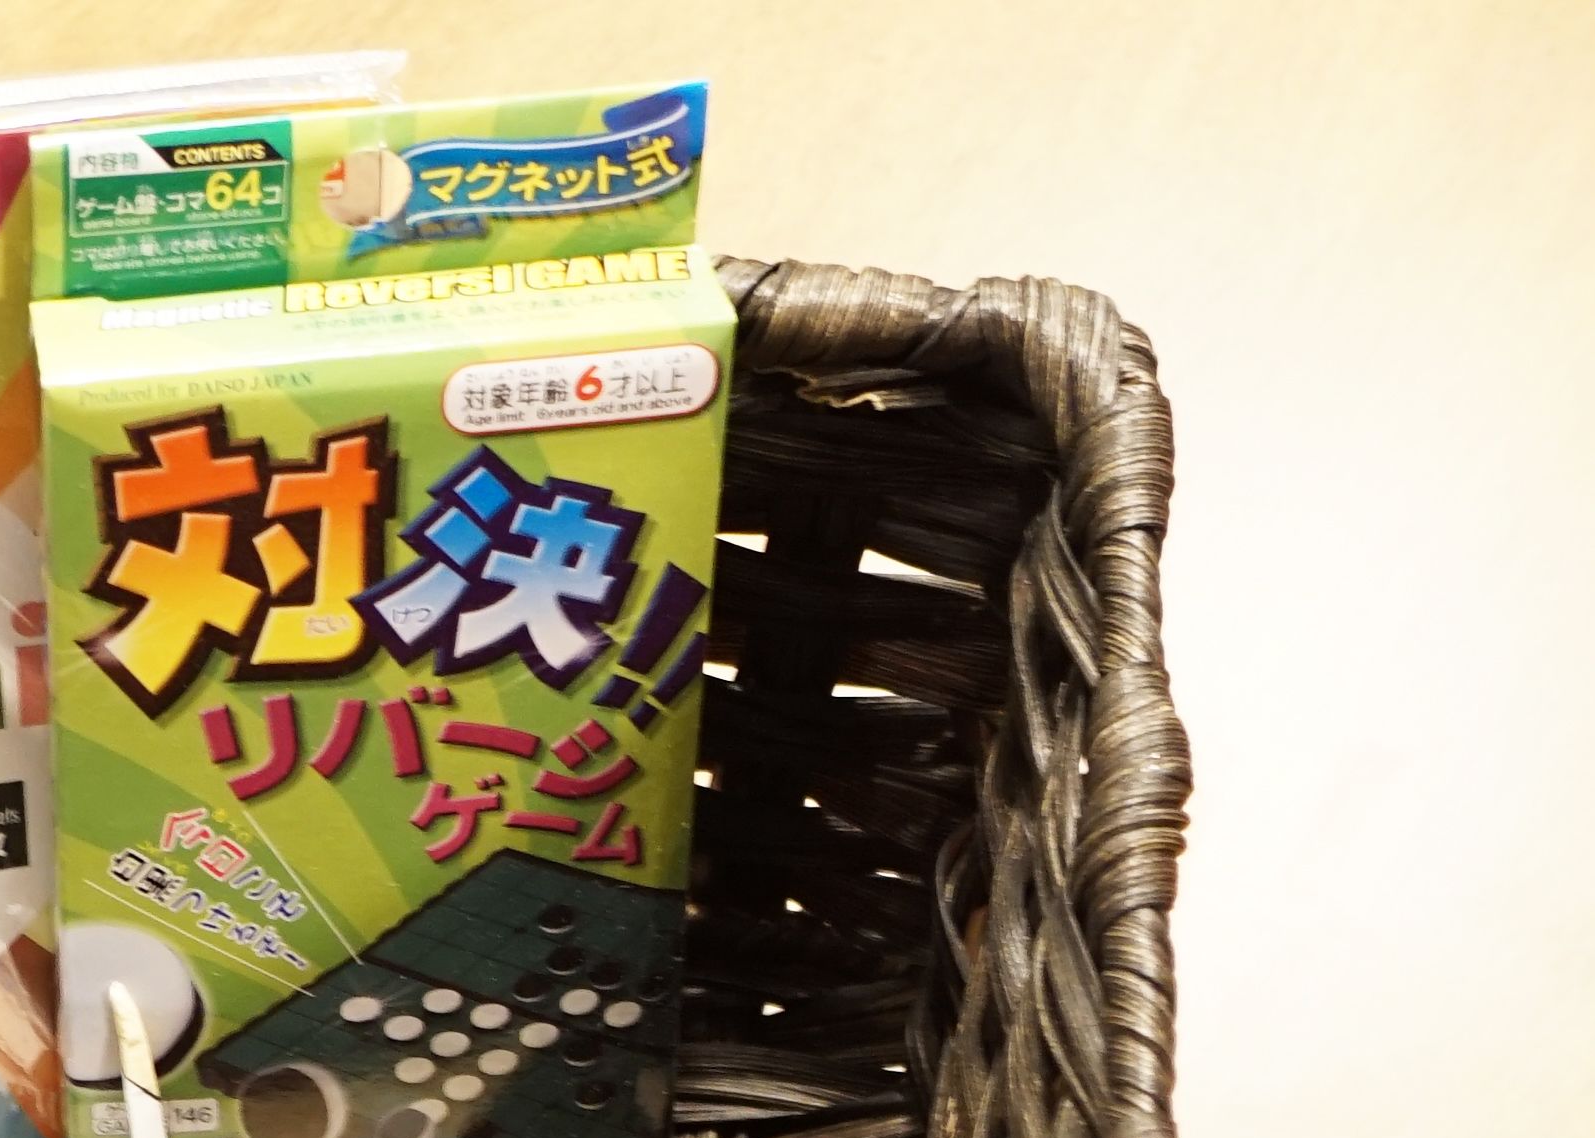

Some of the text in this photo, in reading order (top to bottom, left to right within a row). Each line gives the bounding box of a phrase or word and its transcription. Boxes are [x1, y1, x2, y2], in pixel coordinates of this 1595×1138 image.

[172, 142, 267, 166] CONTENTS
[419, 134, 681, 203] マグネット式
[284, 264, 513, 313] Reversi
[524, 249, 691, 291] GAME
[187, 378, 245, 398] DAISO
[246, 371, 313, 394] JAPAN
[200, 686, 640, 802] リバーシ
[410, 773, 643, 867] ゲーム
[172, 1106, 214, 1124] 146
